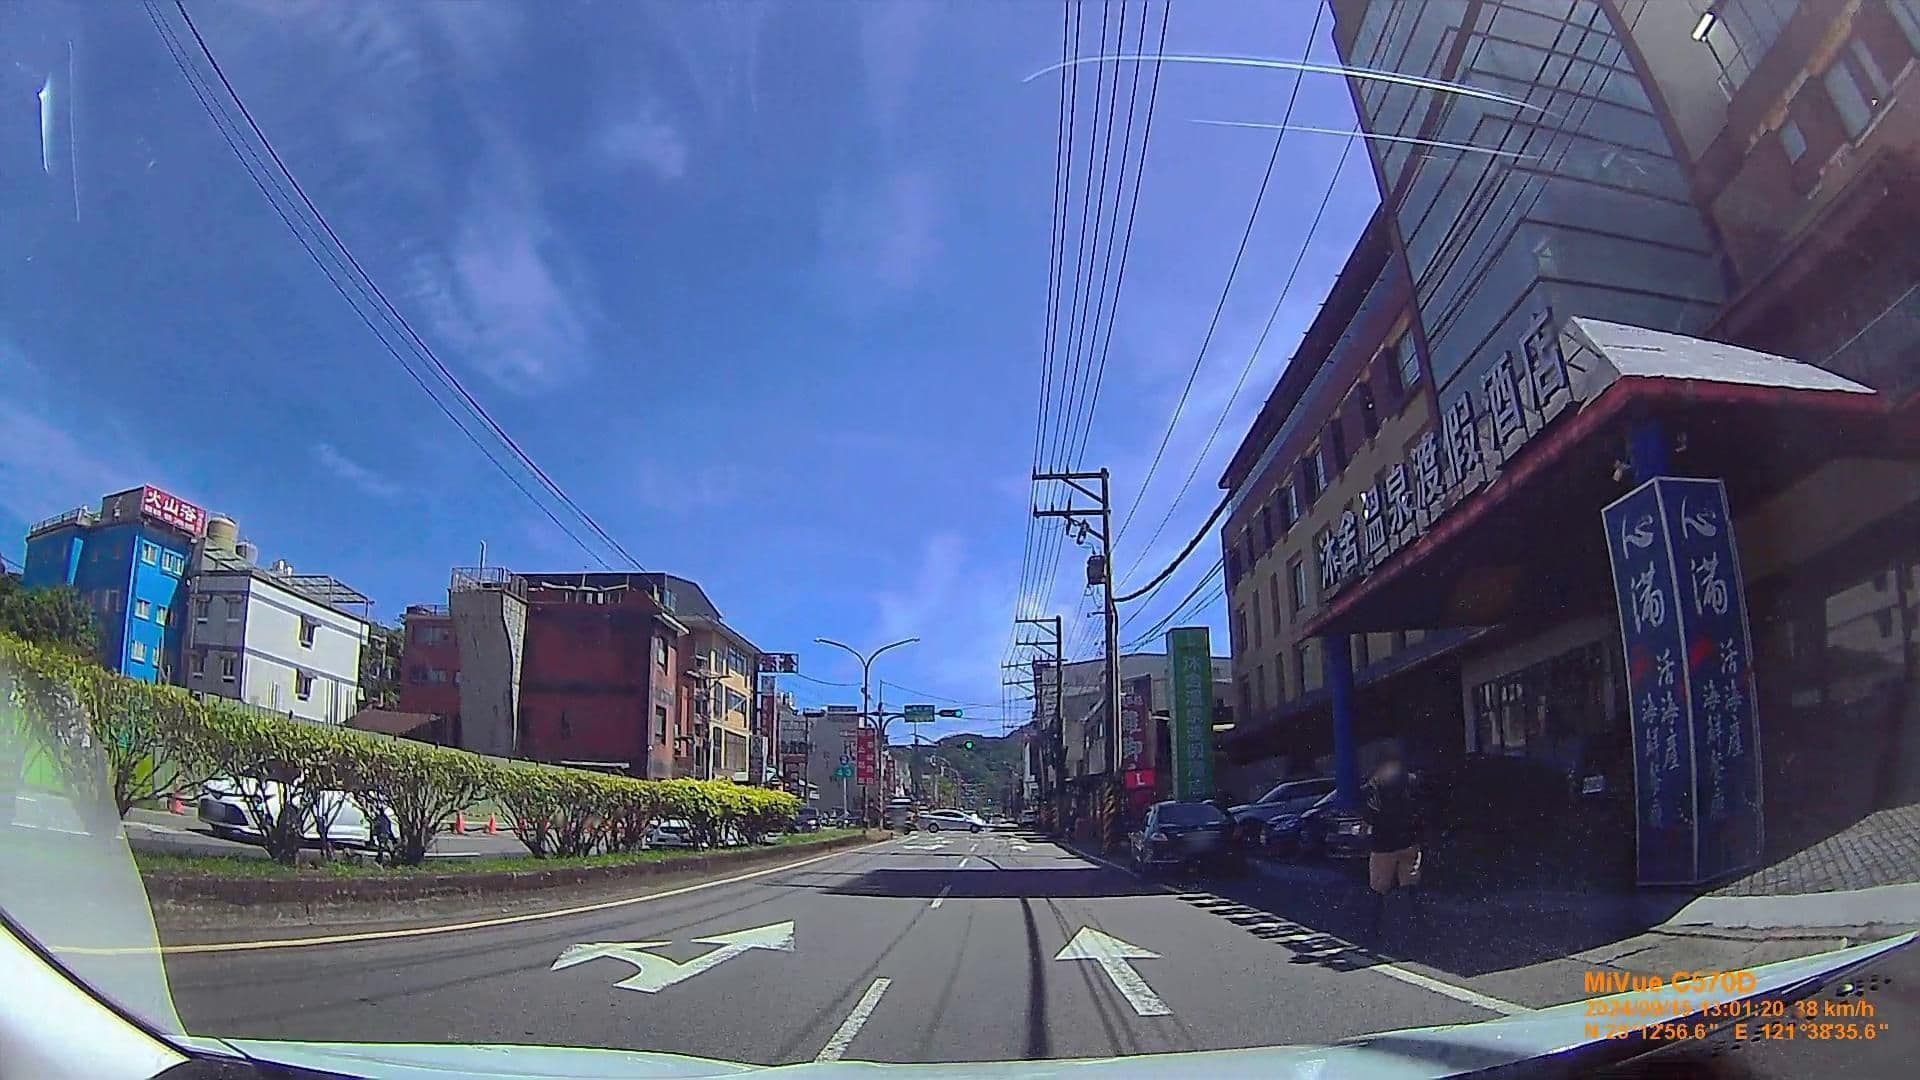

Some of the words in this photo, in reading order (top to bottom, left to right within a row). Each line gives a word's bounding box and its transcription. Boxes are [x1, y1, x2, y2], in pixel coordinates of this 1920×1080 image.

[1319, 305, 1569, 590] 沐舍溫泉渡假酒店
